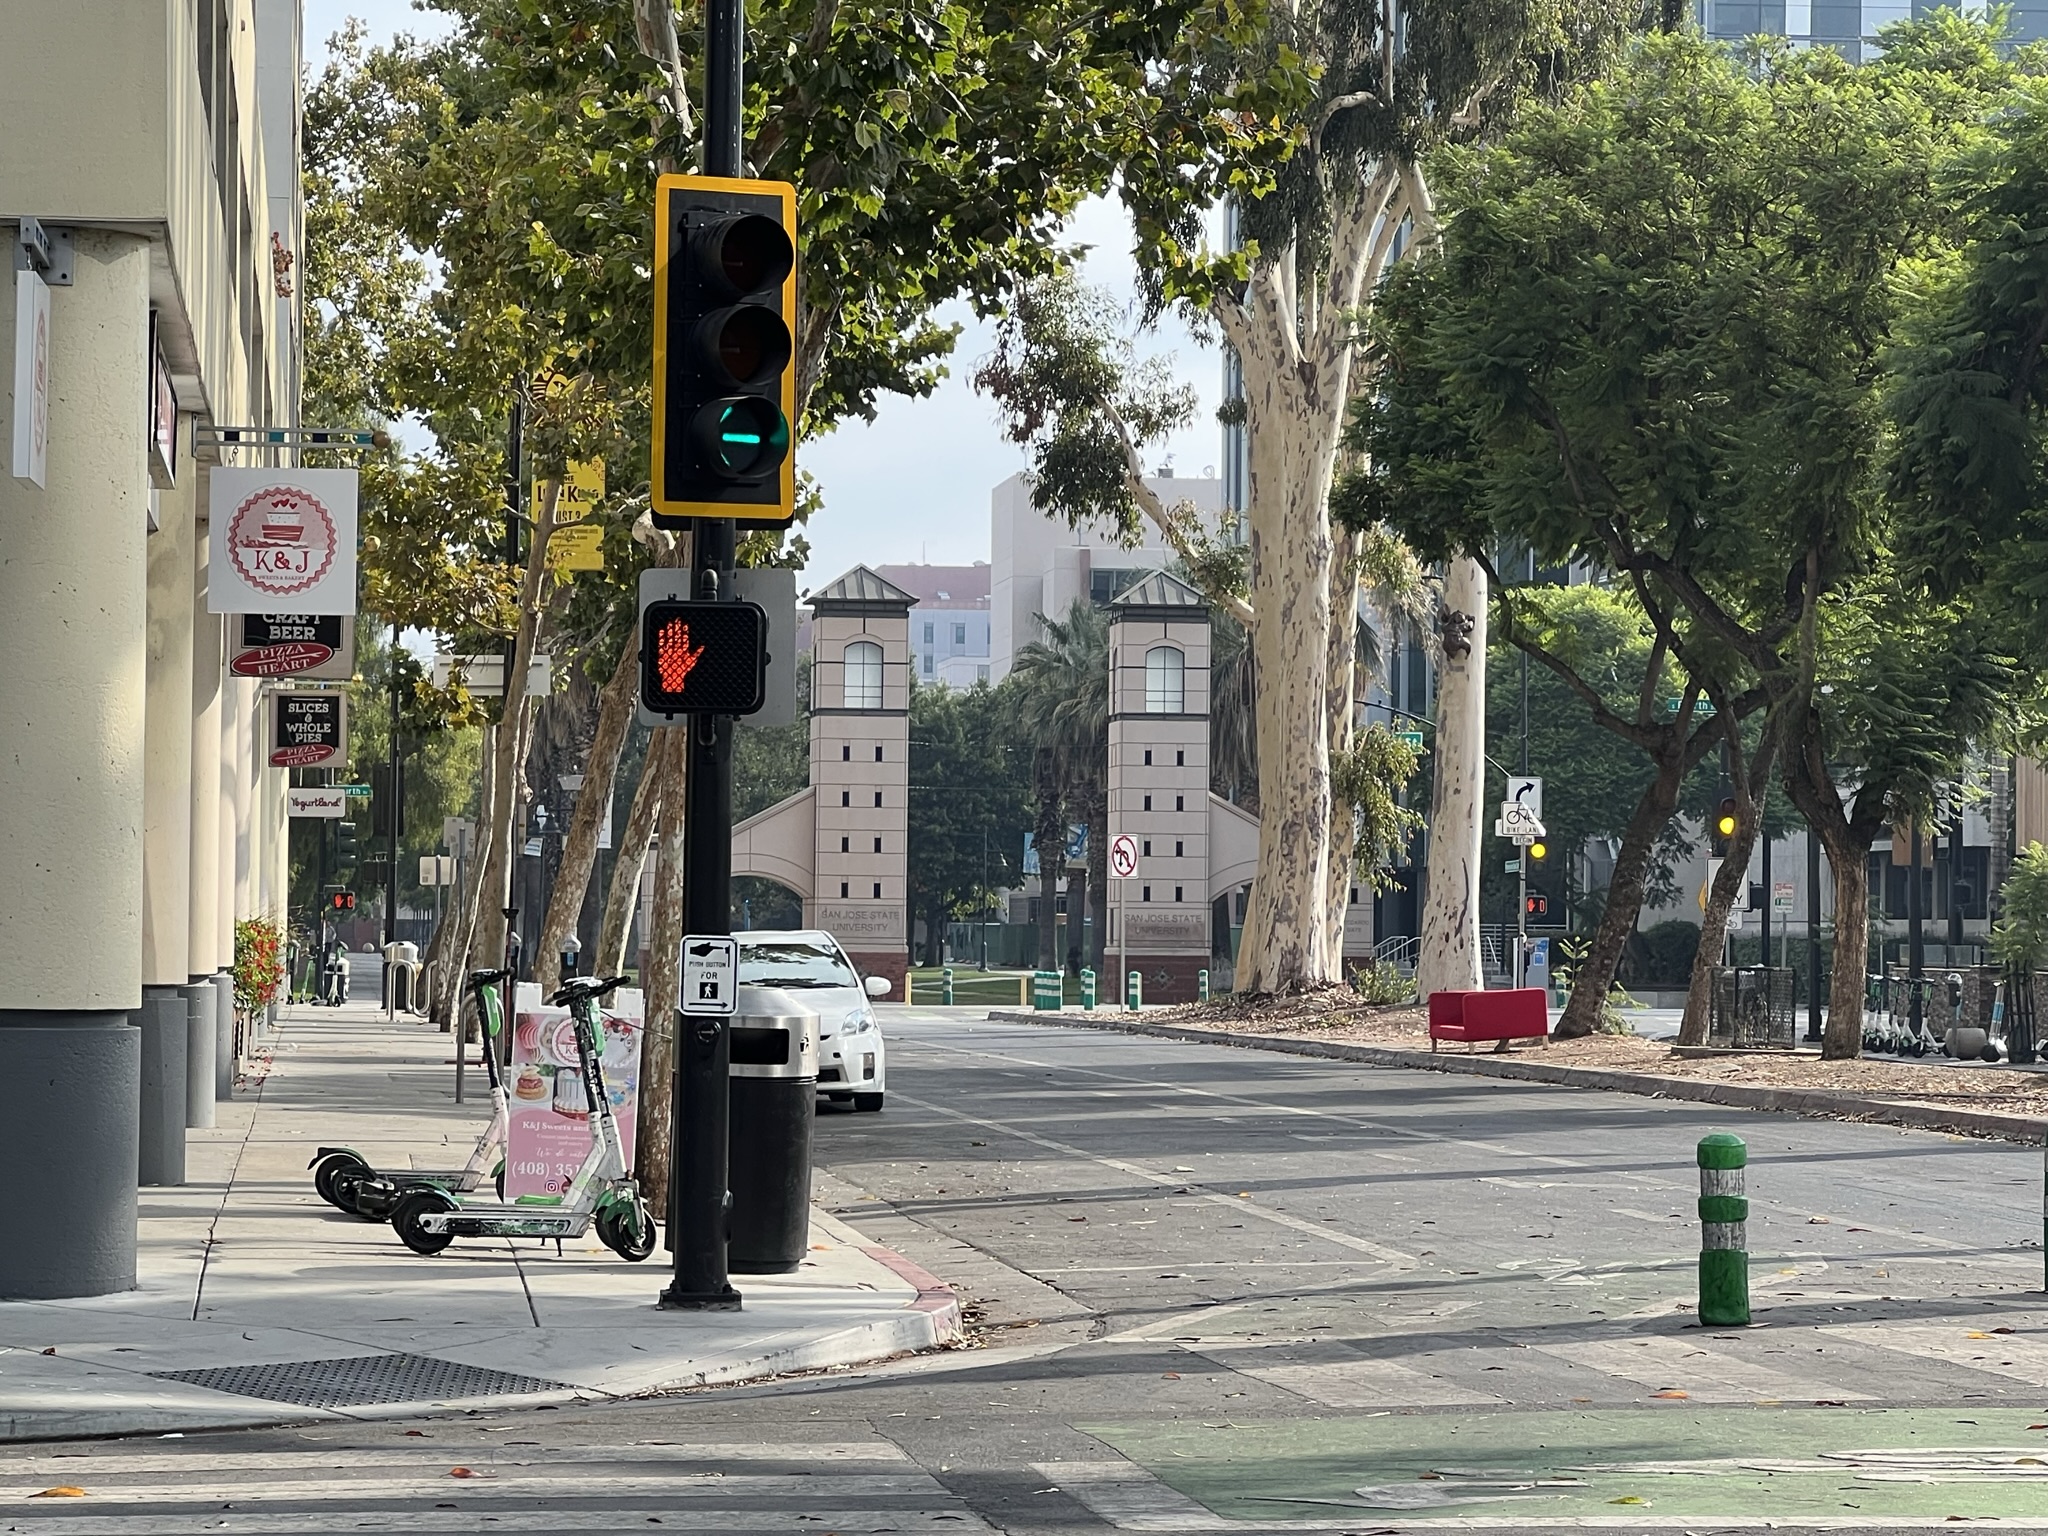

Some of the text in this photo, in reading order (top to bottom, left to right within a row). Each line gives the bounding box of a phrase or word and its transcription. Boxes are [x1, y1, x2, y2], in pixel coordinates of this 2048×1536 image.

[262, 613, 321, 625] CRAFT
[269, 625, 316, 641] BEER
[259, 644, 305, 659] PIZZA
[257, 658, 310, 675] HEART
[287, 703, 329, 713] SLICES
[285, 722, 332, 733] WHOLE
[295, 732, 322, 743] PIES
[286, 745, 317, 755] PIZZA
[286, 754, 320, 766] HEART
[290, 796, 343, 812] Yogurtland
[822, 910, 900, 920] SAN JOSE STATE
[1124, 913, 1202, 924] SAN JOSE STATE
[832, 923, 889, 932] UNIVERSITY
[1134, 926, 1190, 935] UNIVERSITY
[522, 1121, 541, 1132] K&J
[542, 1122, 572, 1131] Sweets
[511, 1161, 550, 1179] (408)
